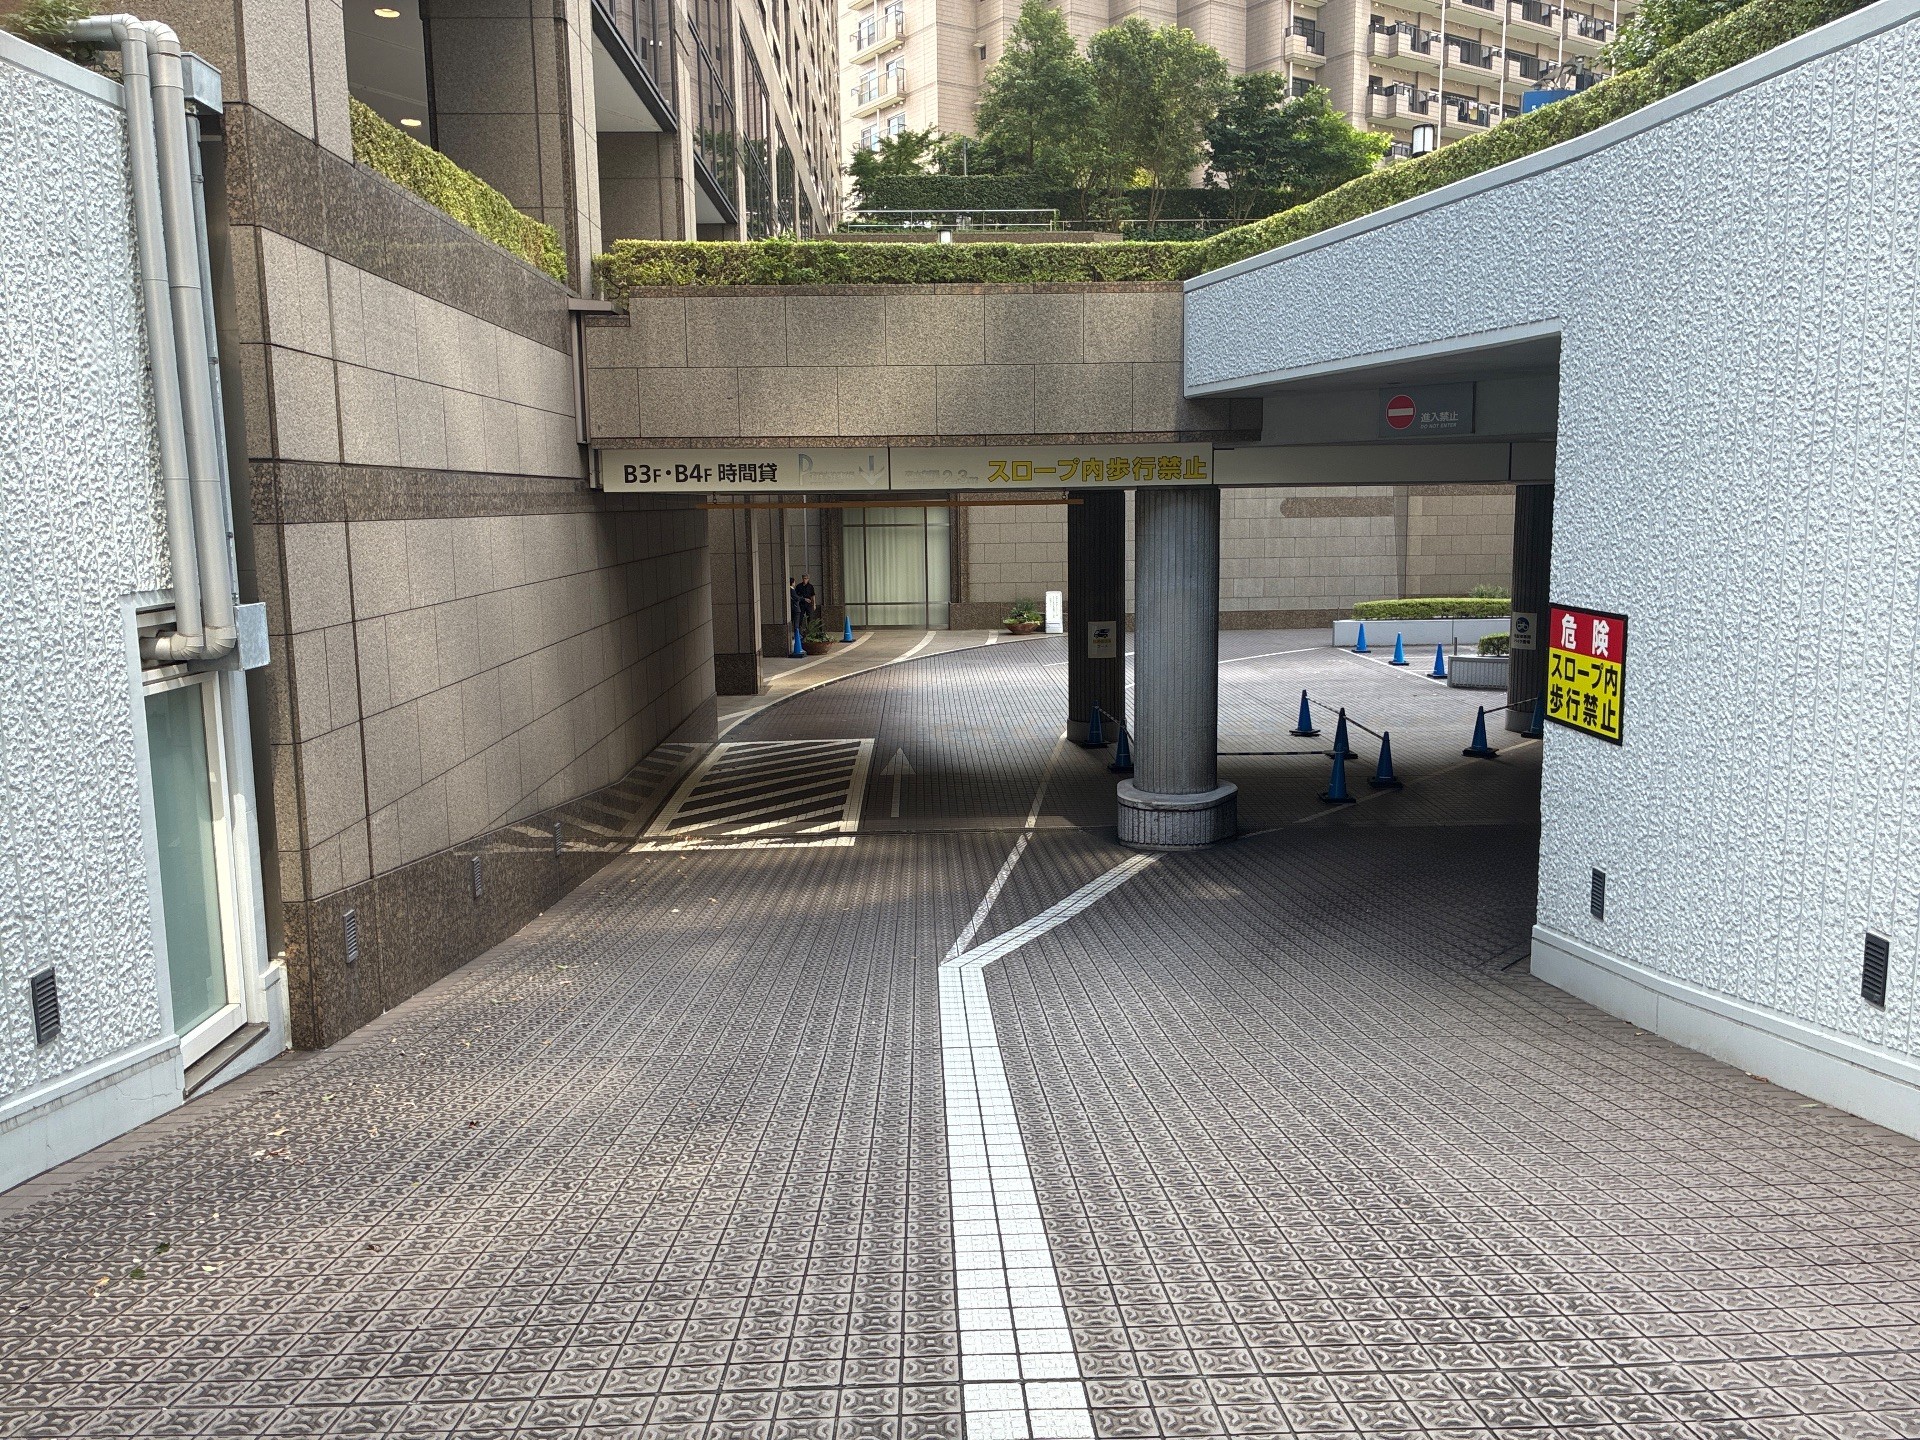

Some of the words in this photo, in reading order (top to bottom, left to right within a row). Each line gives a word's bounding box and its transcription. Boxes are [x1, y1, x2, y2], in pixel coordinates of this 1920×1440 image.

[1420, 411, 1459, 423] 進入禁止
[717, 462, 778, 483] 時間貸
[987, 455, 1208, 483] スロープ内歩行禁止
[1561, 613, 1610, 658] 危険
[1551, 653, 1618, 697] スロープ内
[1550, 683, 1616, 734] 歩行禁止
